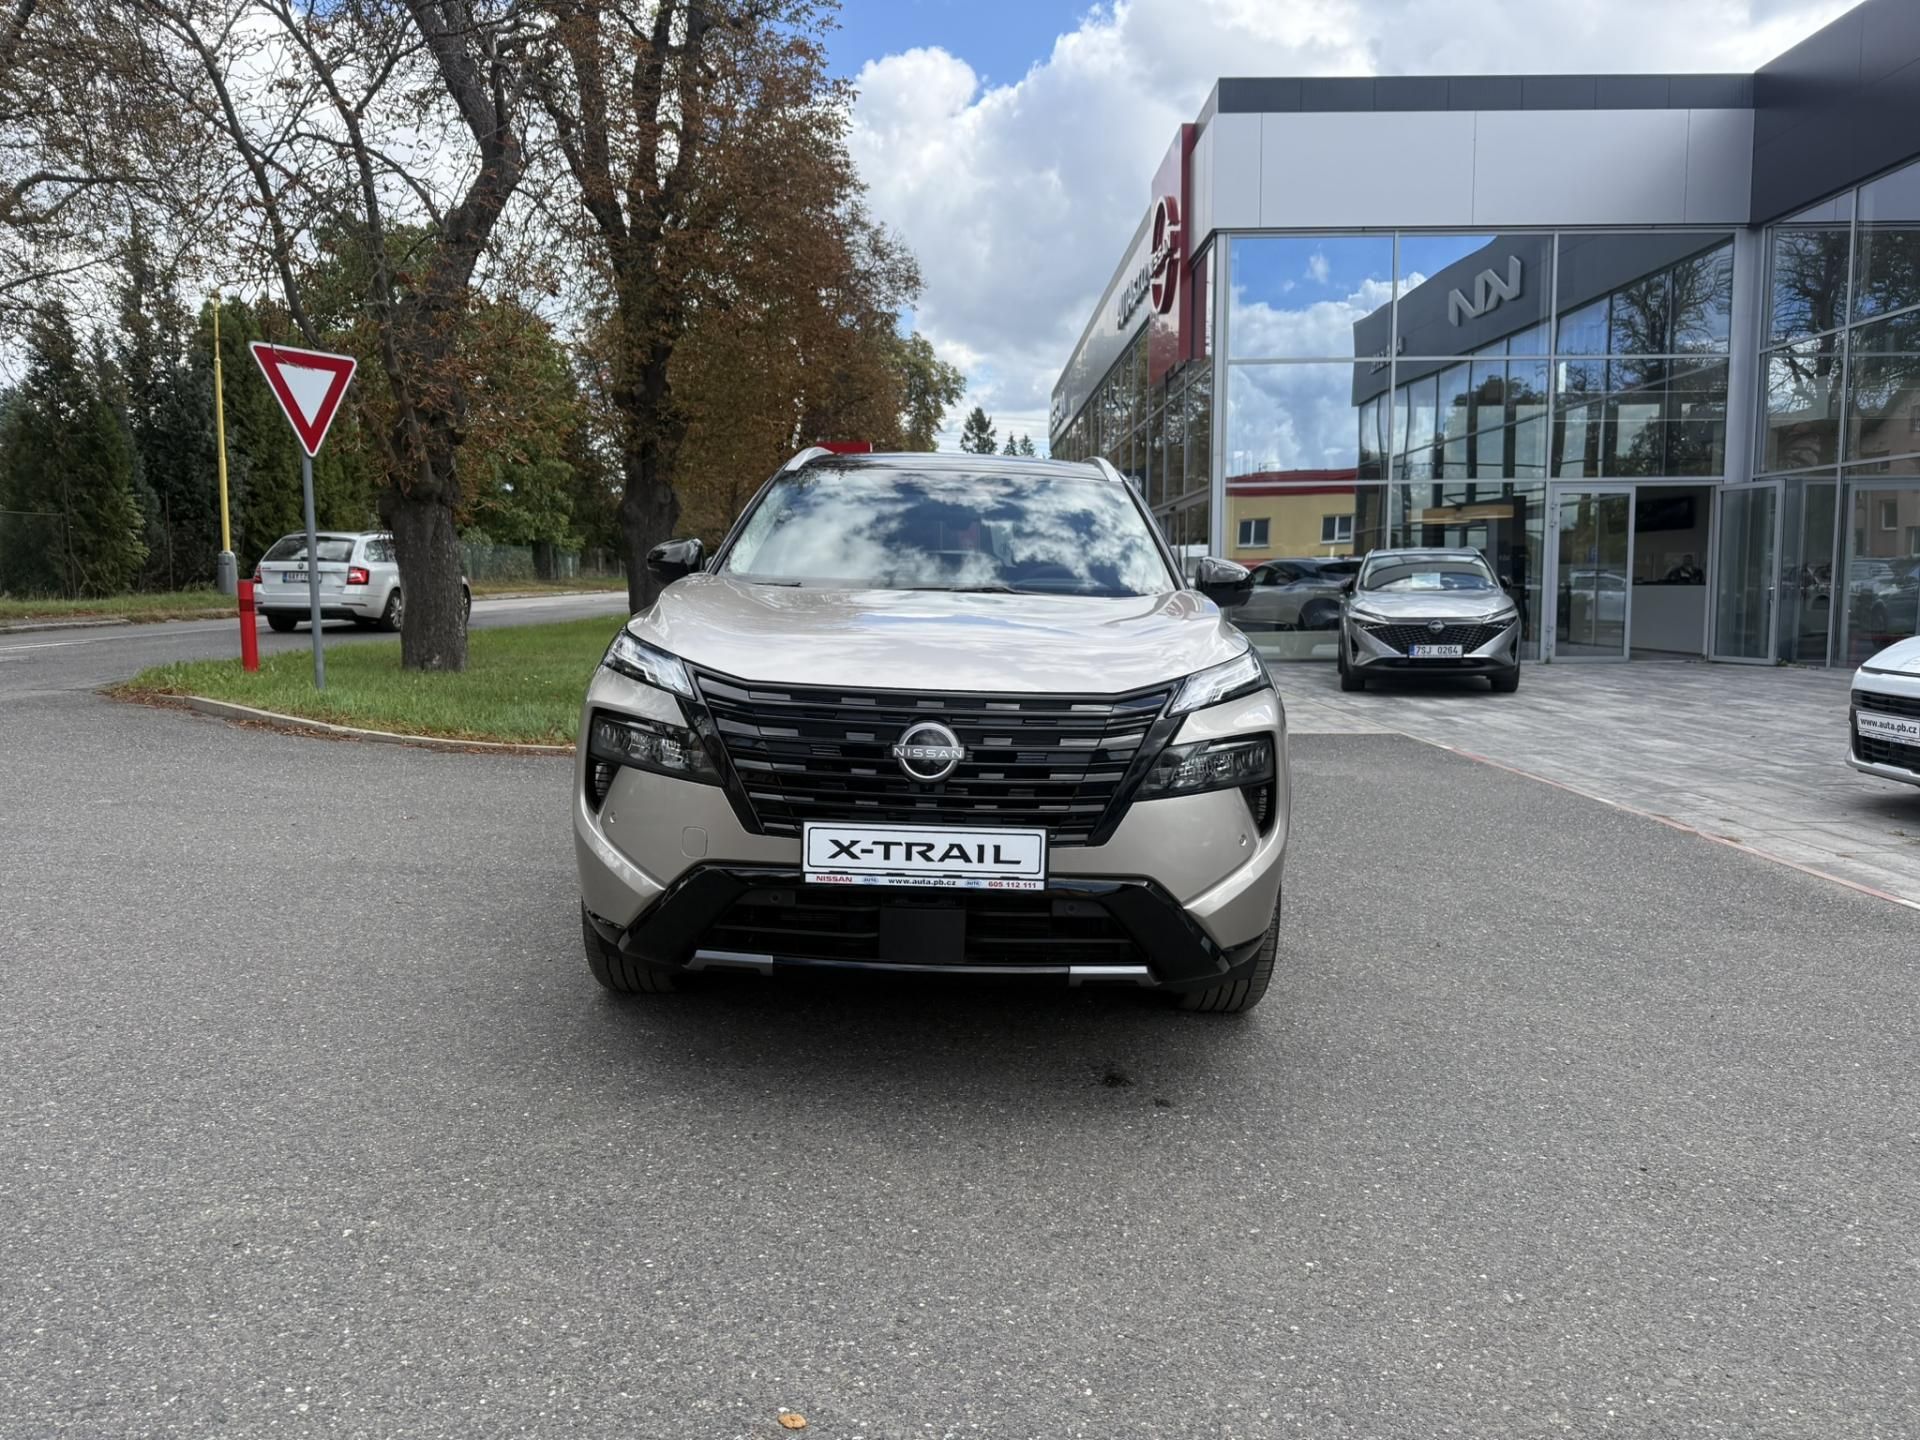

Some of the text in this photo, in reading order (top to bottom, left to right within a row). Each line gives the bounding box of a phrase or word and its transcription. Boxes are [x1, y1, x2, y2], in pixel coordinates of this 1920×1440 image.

[1416, 646, 1458, 655] 7SJ 0264
[1860, 719, 1917, 734] www.auta.pb.cz
[893, 747, 962, 759] NISSAN
[827, 839, 1022, 865] X-TRAIL
[816, 875, 853, 883] NISSAN
[888, 878, 956, 886] www.auta.pb.cz
